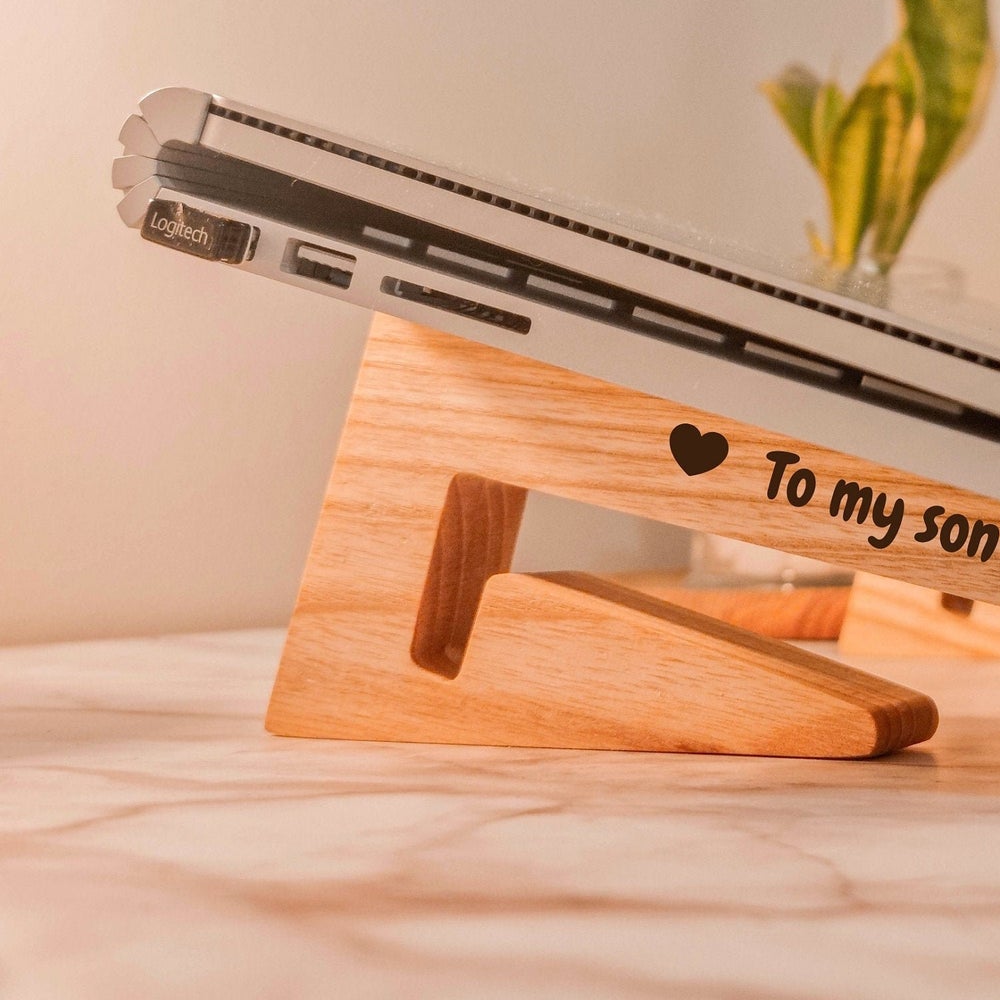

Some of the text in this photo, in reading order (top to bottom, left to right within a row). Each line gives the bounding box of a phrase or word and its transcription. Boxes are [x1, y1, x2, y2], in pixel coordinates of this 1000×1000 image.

[150, 211, 208, 245] Logitech
[765, 450, 816, 507] To
[829, 478, 905, 549] my
[914, 505, 1000, 562] son
